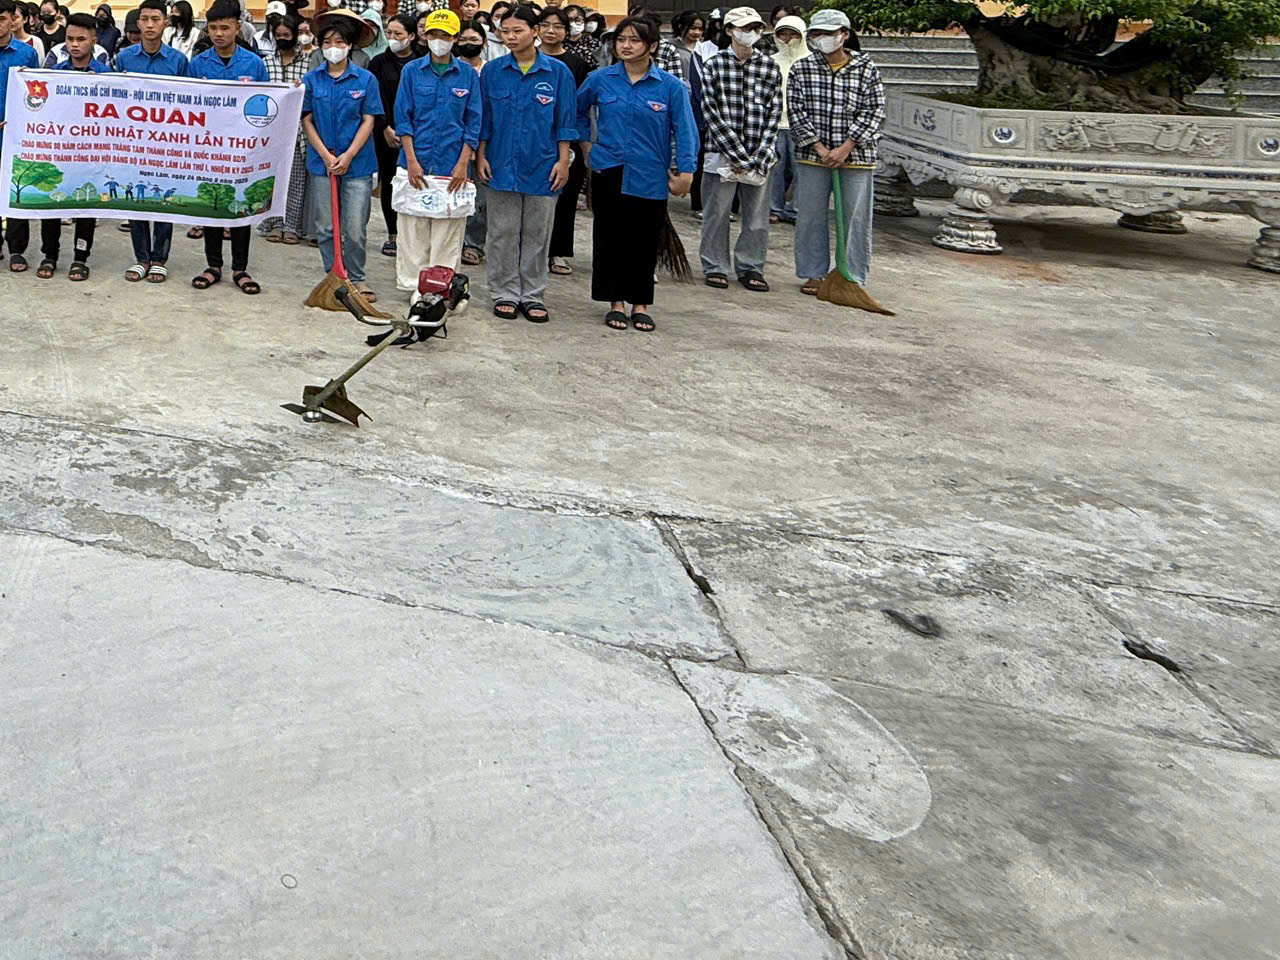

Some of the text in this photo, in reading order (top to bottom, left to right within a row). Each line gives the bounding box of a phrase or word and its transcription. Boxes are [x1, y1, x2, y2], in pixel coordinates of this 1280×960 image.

[56, 84, 72, 96] ĐOÀN
[73, 86, 88, 96] TNCS
[90, 84, 98, 97] HỒ
[100, 86, 110, 97] CHÍ
[112, 88, 128, 99] MINH
[134, 88, 144, 102] HỘI
[146, 90, 160, 102] LHTN
[163, 91, 176, 105] VIỆT
[177, 94, 192, 105] NAM
[194, 94, 202, 106] XÃ
[204, 96, 221, 109] NGỌC
[84, 102, 206, 128] RA QUÂN
[26, 121, 270, 149] NGÀY CHỦ NHẬT XANH LẦN THỨ V
